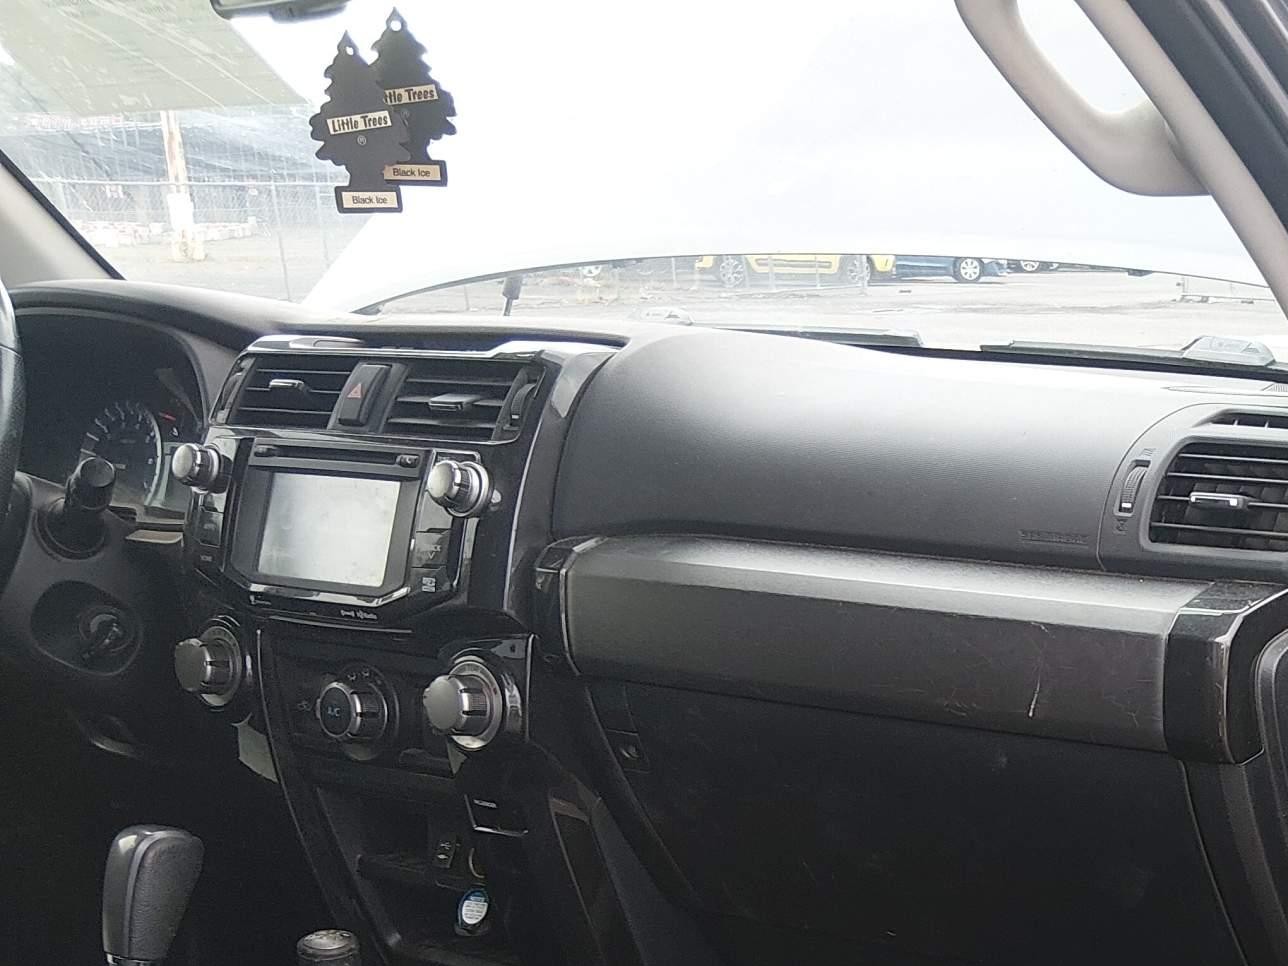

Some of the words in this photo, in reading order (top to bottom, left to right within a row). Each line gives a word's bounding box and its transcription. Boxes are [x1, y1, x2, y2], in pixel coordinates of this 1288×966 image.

[384, 90, 403, 103] ttle
[405, 88, 434, 102] Trees
[332, 117, 360, 132] Little
[360, 115, 388, 129] Trees
[392, 167, 416, 177] Black
[418, 168, 431, 177] Ice
[352, 195, 374, 205] Black
[376, 195, 388, 205] Ice
